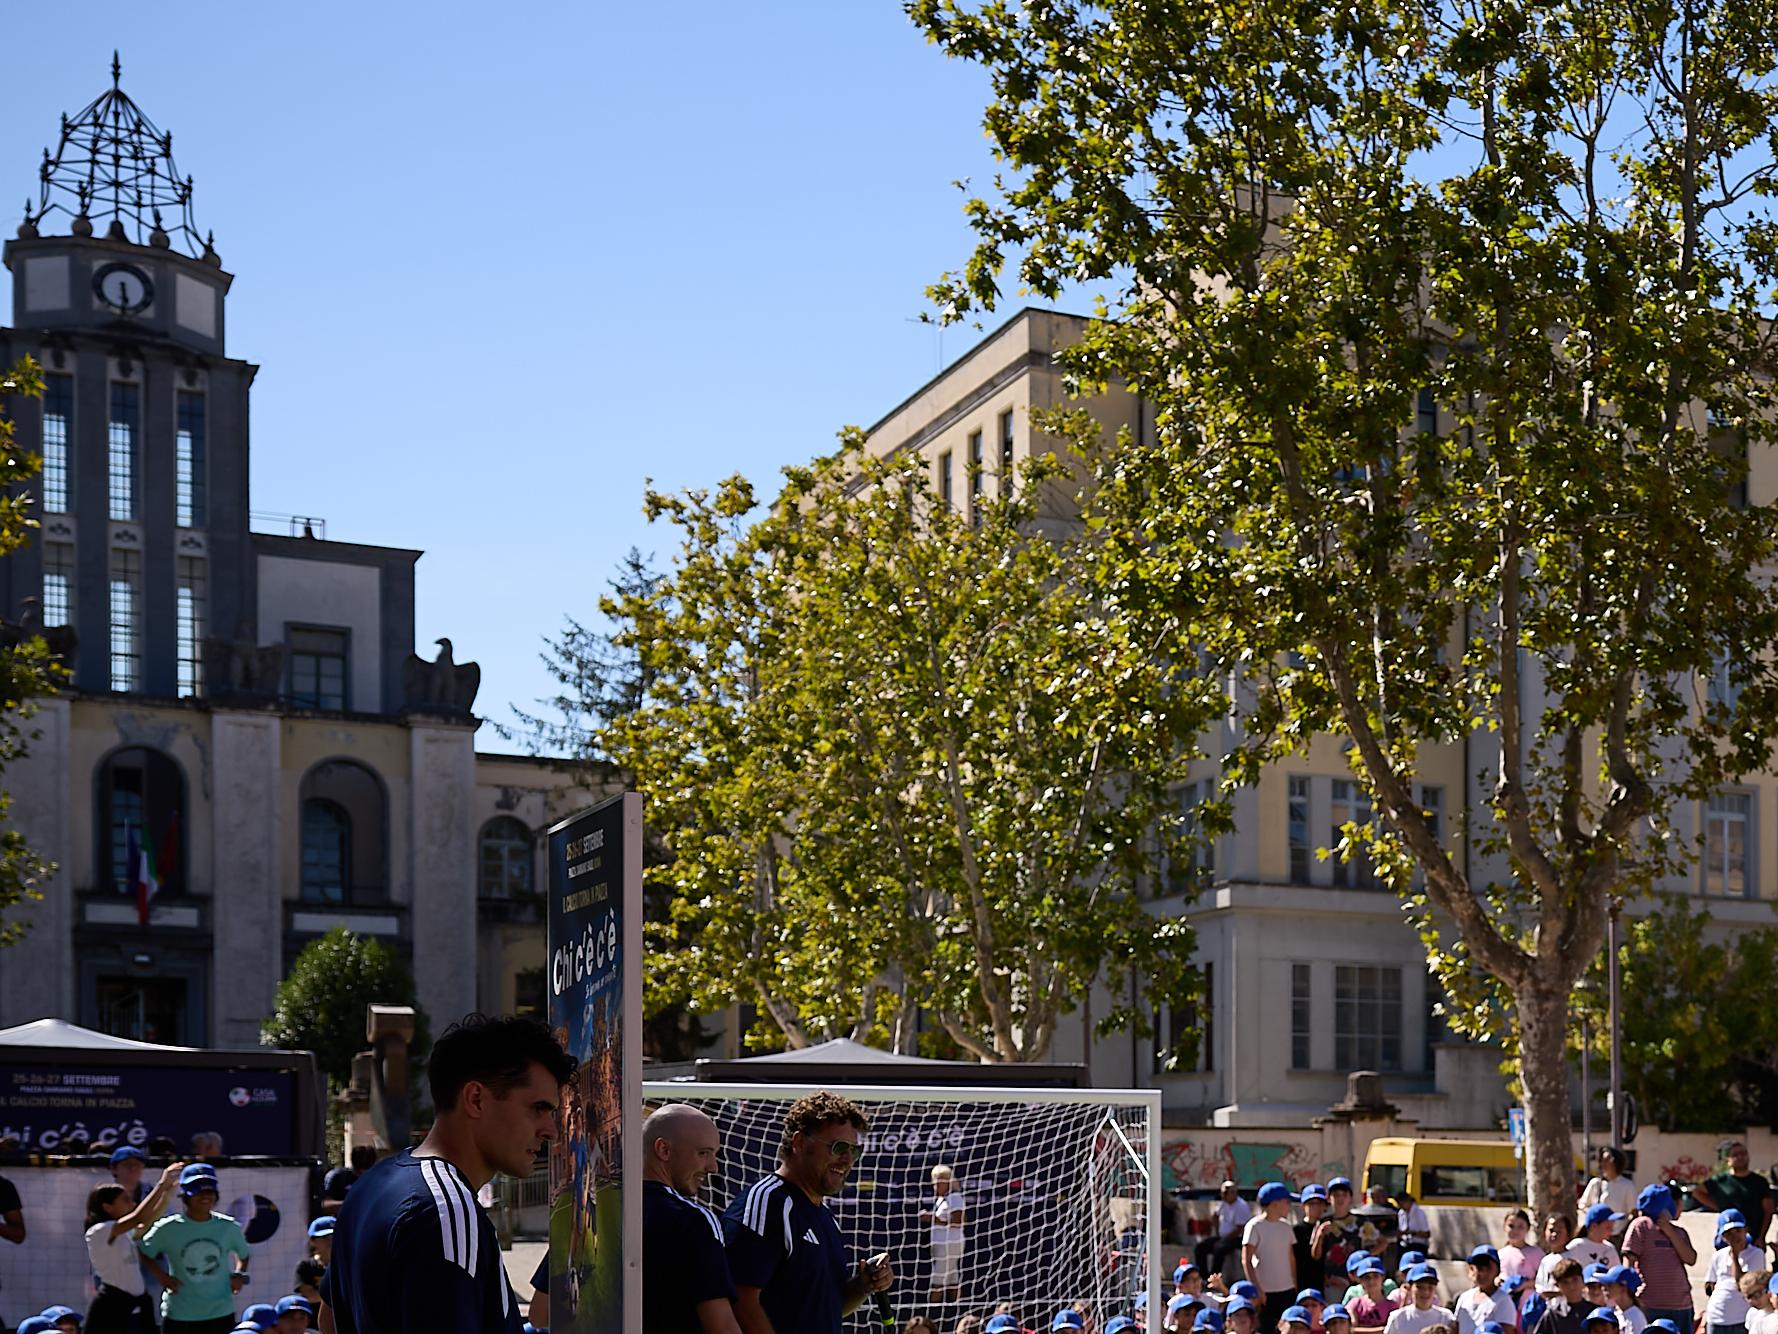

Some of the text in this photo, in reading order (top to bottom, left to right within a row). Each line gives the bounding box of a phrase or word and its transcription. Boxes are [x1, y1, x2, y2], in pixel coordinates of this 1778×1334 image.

[553, 940, 574, 996] Chi
[575, 922, 594, 983] c'è
[596, 906, 616, 969] c'è
[62, 1074, 121, 1086] SETTEMBRE
[10, 1096, 47, 1107] CALCIO
[50, 1096, 83, 1108] TORNA
[85, 1097, 97, 1108] IN
[99, 1097, 137, 1109] PIAZZA
[97, 1118, 148, 1146] c'è
